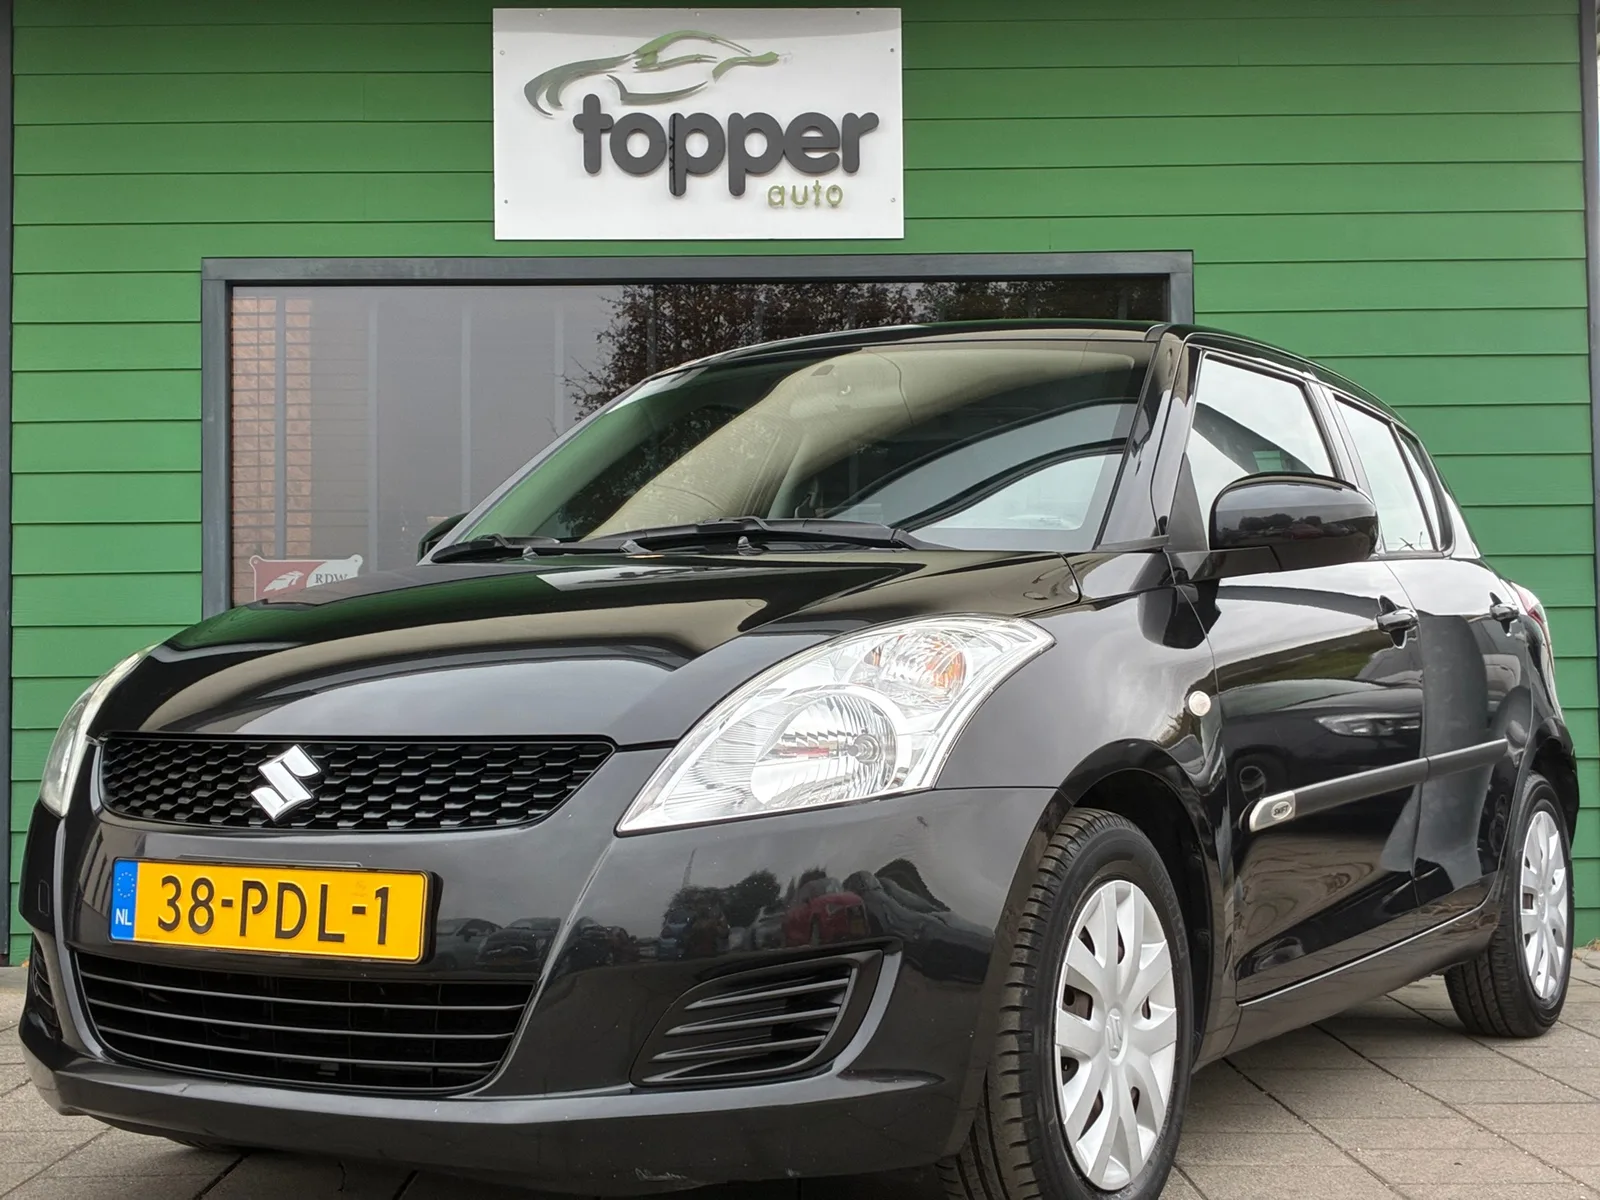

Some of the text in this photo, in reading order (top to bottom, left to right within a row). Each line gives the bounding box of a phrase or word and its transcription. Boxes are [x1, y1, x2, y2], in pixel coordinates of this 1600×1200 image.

[573, 93, 879, 197] topper
[767, 180, 843, 207] auto
[115, 909, 132, 926] NL
[158, 875, 390, 945] 38-PDL-1
